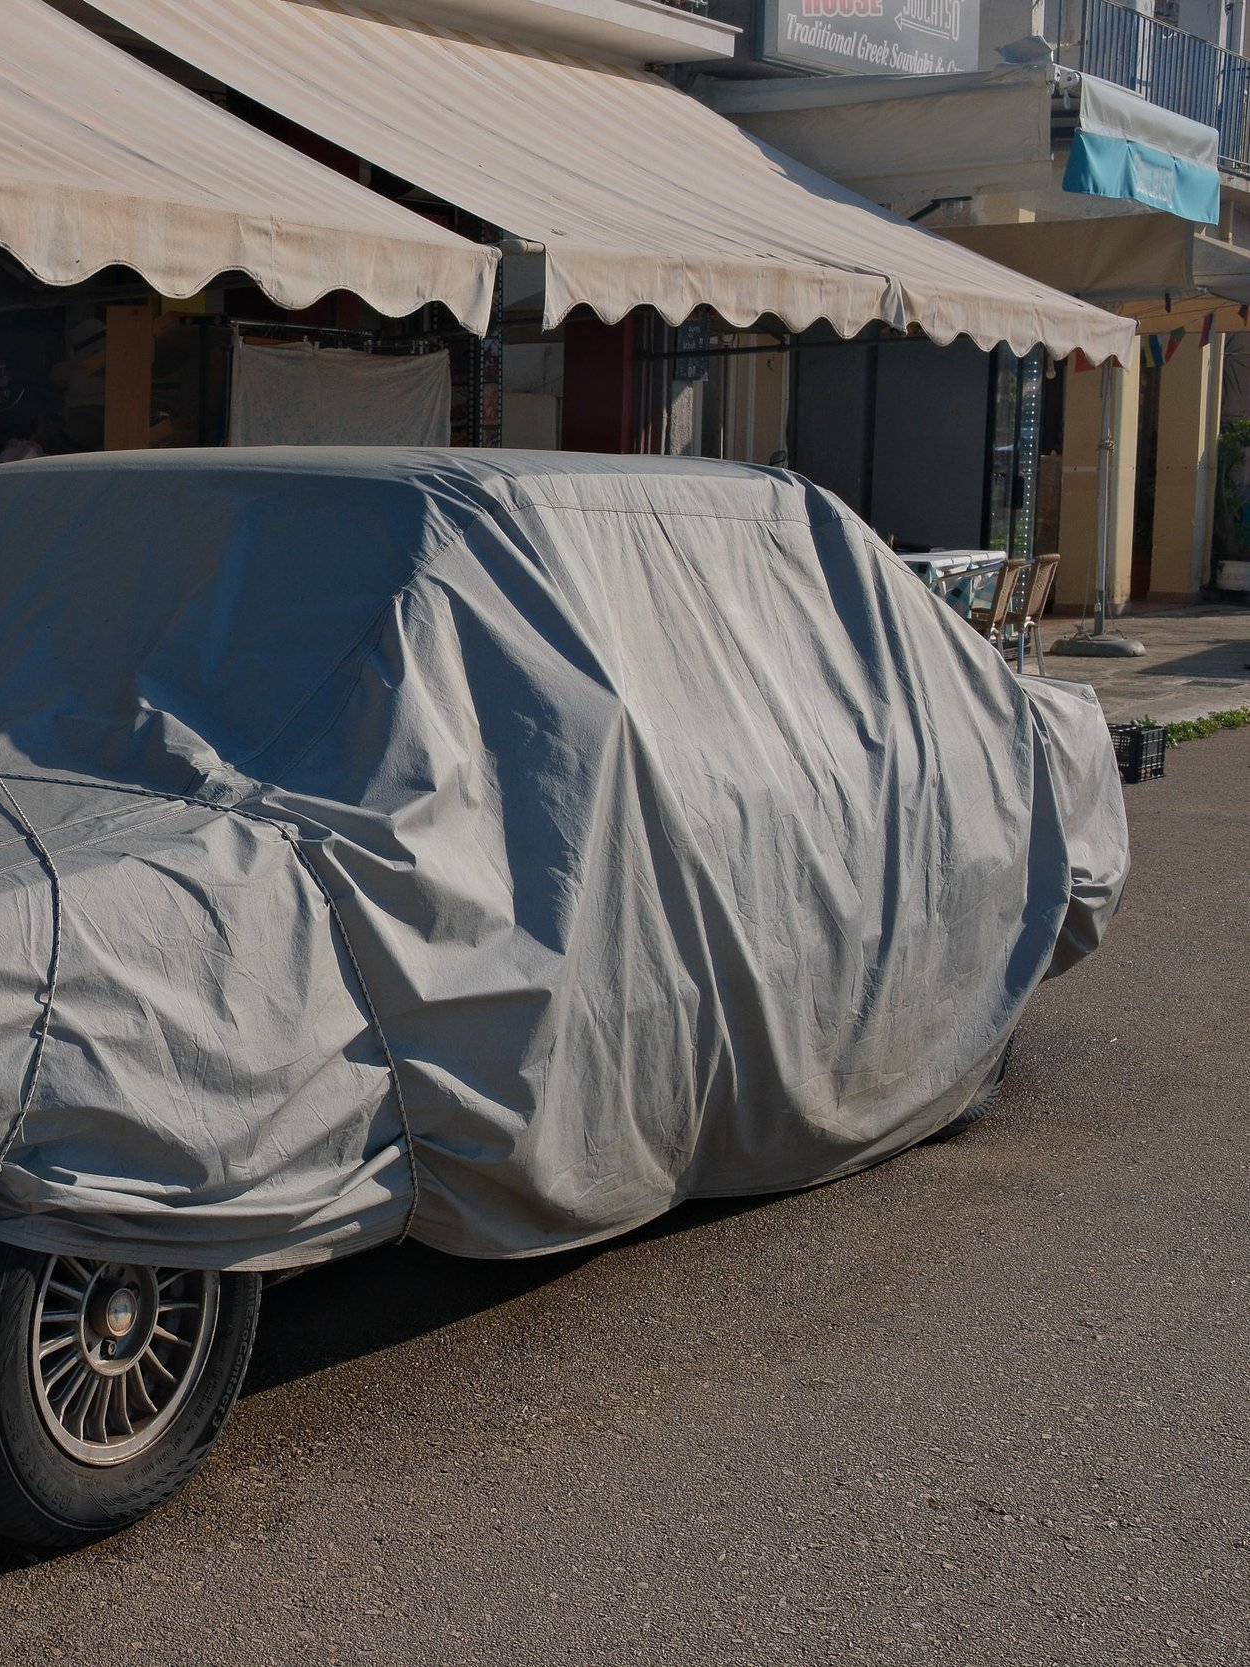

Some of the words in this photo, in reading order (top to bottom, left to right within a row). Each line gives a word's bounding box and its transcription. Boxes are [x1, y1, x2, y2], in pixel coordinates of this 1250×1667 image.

[786, 12, 858, 57] Traditional
[857, 33, 890, 66] Greek
[889, 43, 934, 72] Souvlaki
